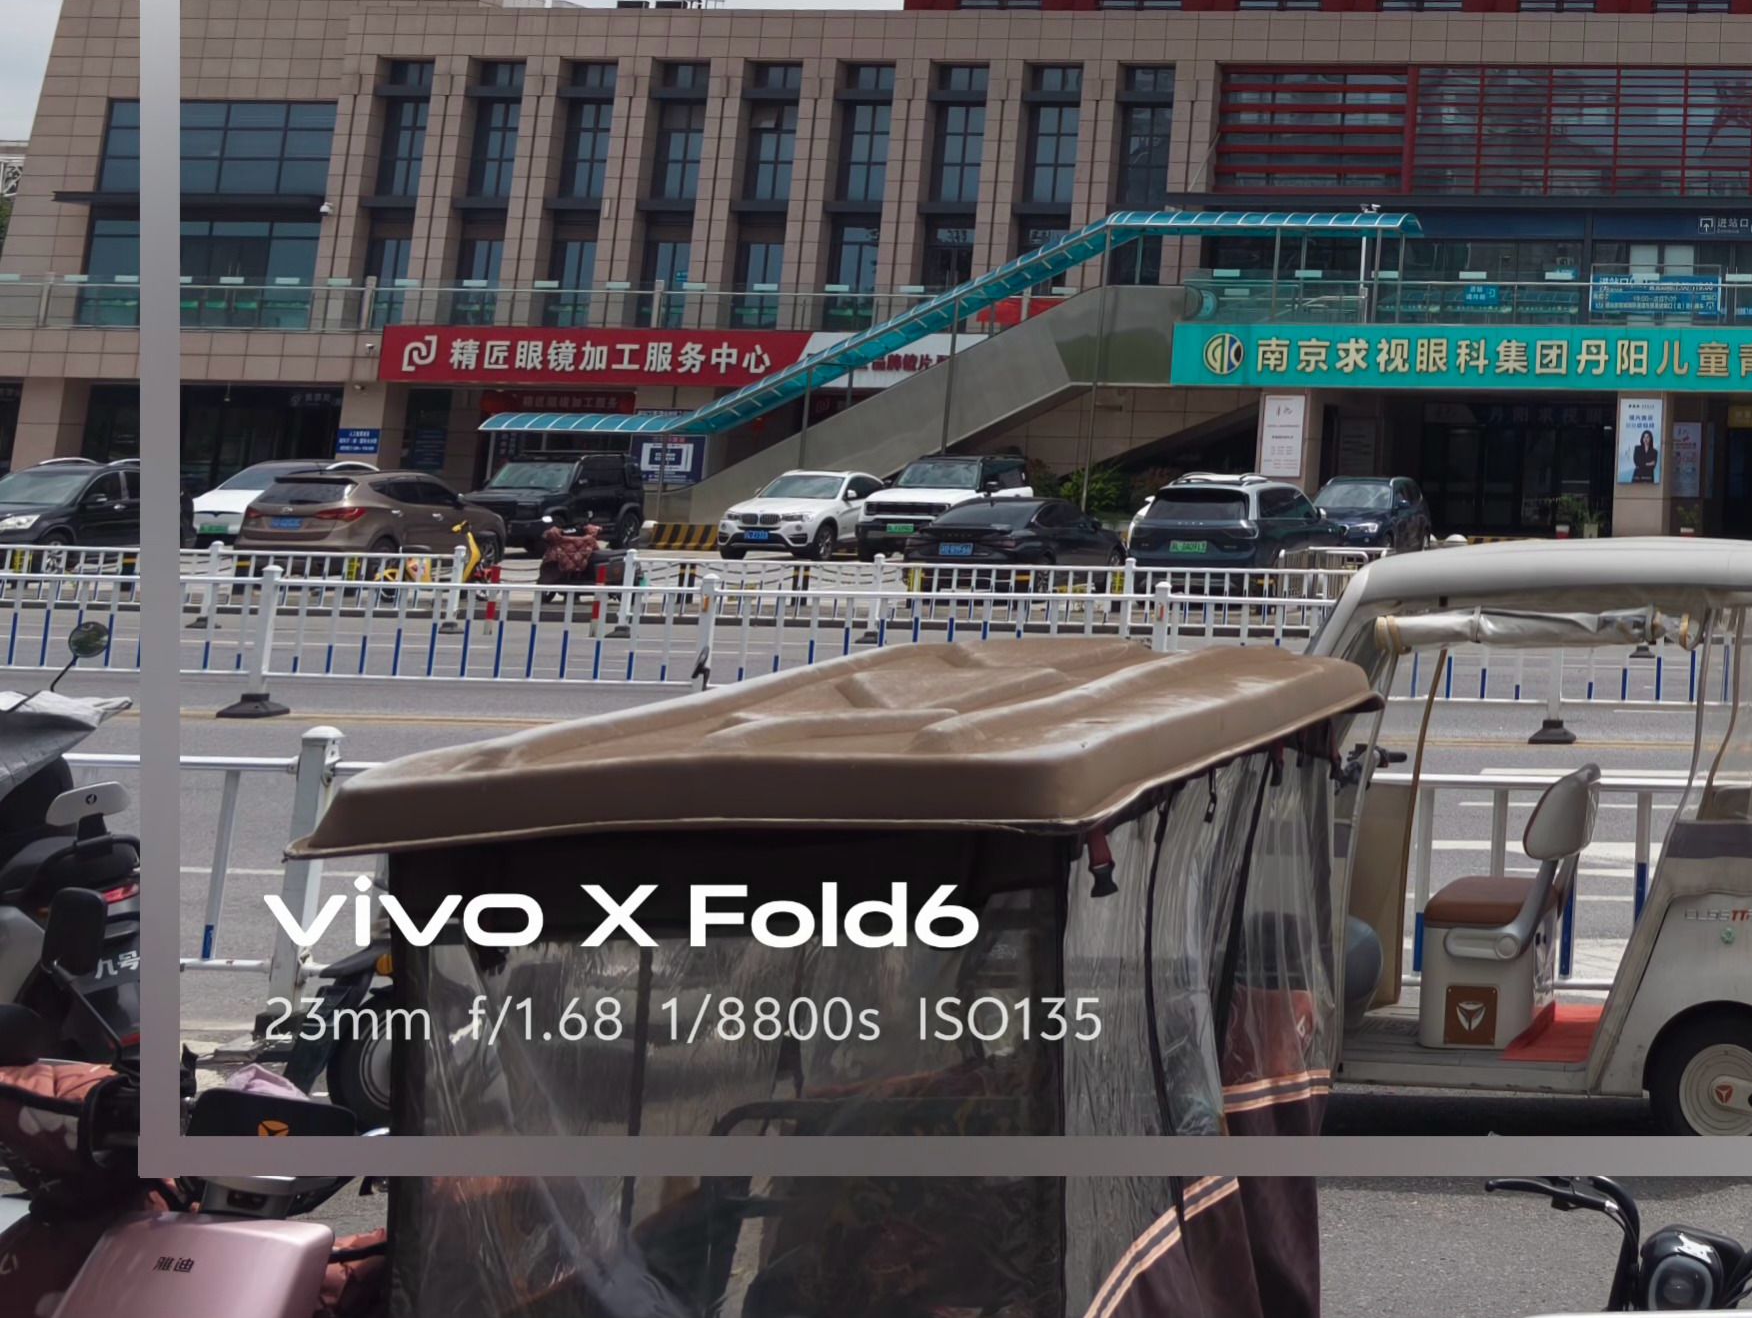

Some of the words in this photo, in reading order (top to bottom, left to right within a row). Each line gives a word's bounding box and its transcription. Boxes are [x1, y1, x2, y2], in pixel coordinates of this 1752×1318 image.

[1717, 218, 1748, 228] 进站口
[450, 339, 772, 374] 精匠眼镜加工服务中心
[152, 1256, 195, 1273] 雅迪
